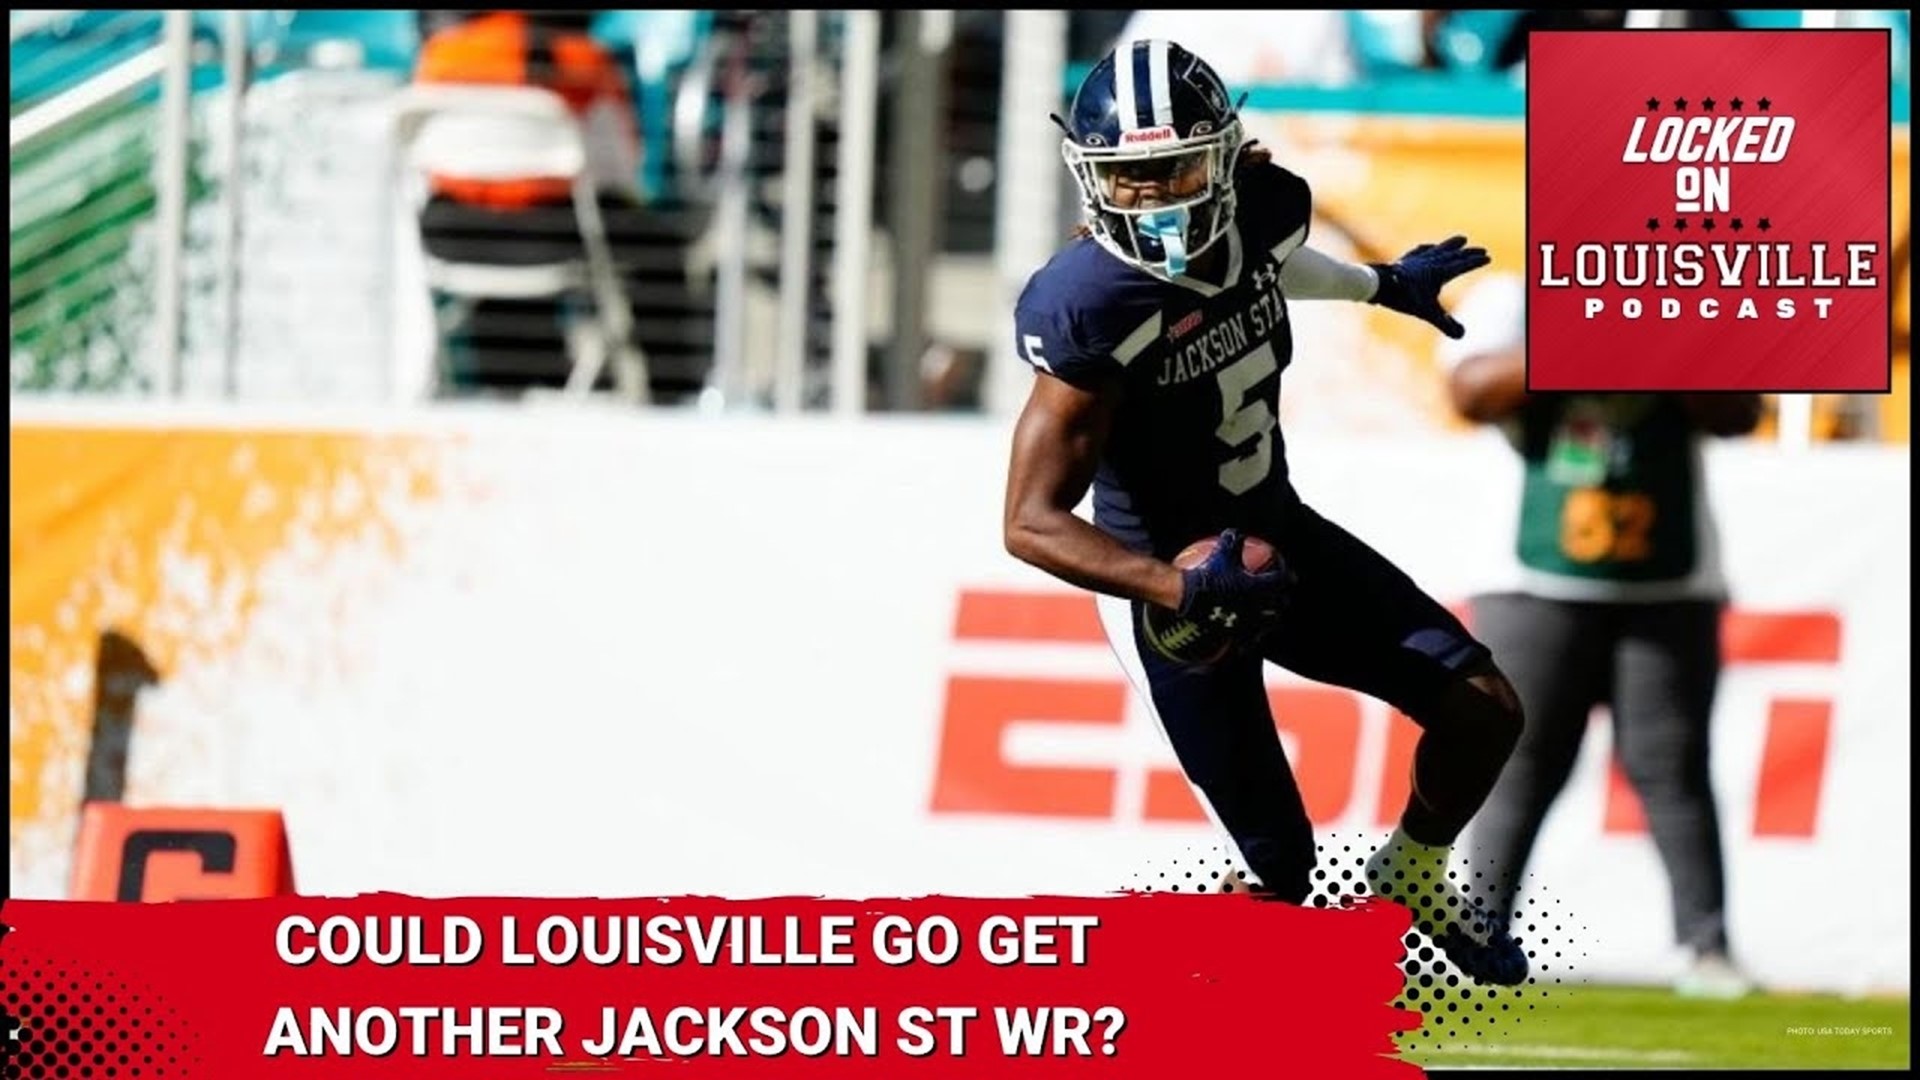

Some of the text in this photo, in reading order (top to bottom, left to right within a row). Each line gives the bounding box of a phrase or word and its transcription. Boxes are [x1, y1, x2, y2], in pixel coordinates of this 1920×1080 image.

[1124, 128, 1172, 144] Riddell
[1157, 312, 1248, 386] JACKSON
[1215, 341, 1278, 496] 5
